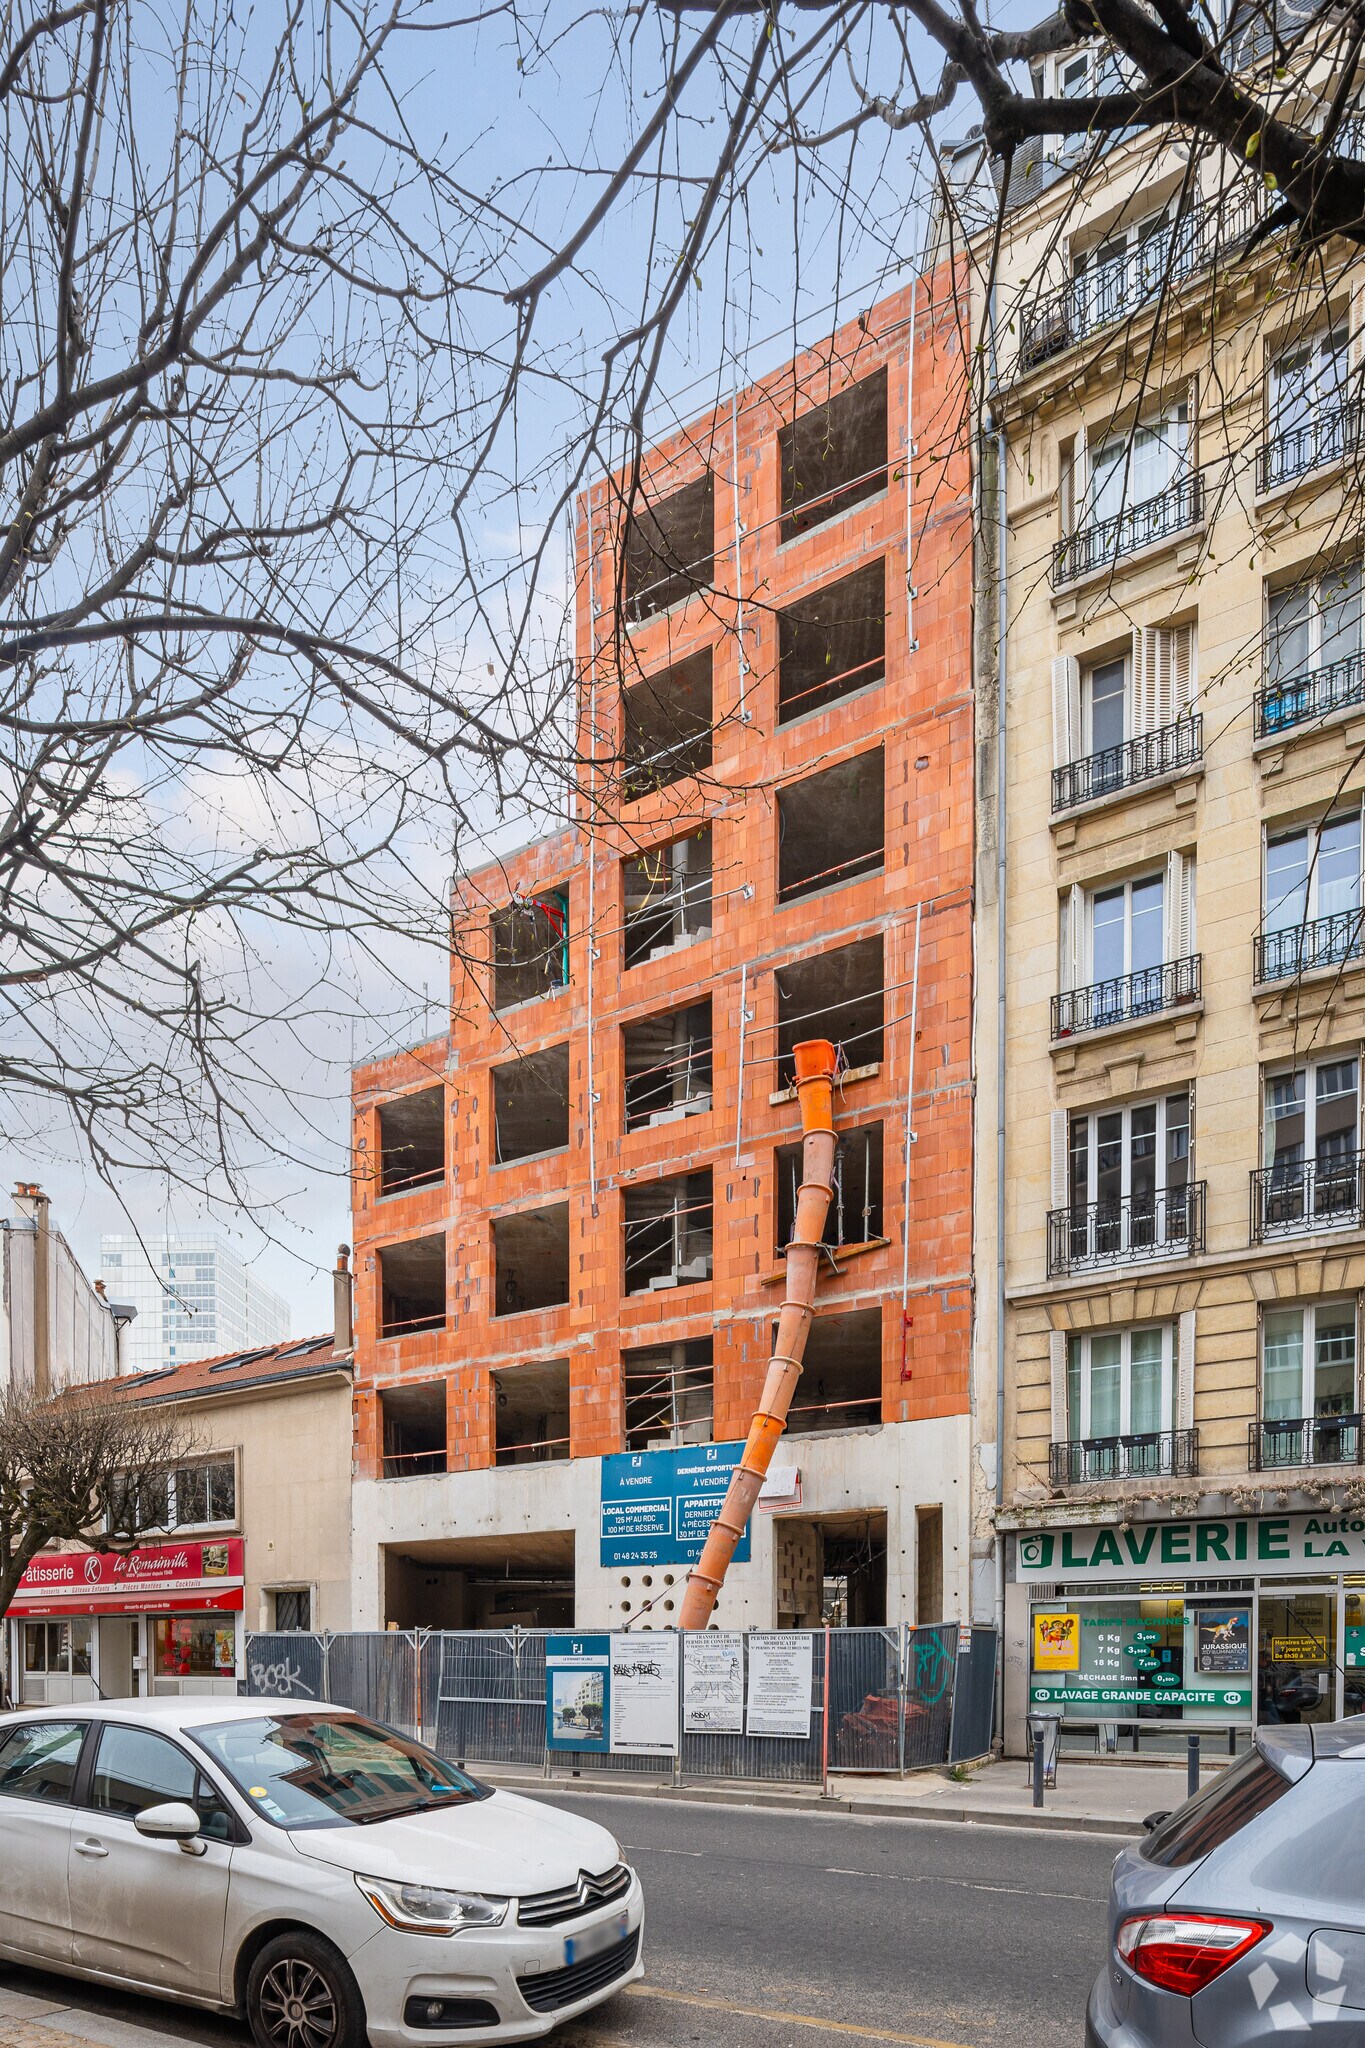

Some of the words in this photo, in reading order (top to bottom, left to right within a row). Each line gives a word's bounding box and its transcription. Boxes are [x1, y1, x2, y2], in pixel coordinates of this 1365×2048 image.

[677, 1466, 705, 1475] DERNIÈRE
[620, 1477, 625, 1486] À
[626, 1476, 652, 1485] VENDRE
[693, 1478, 699, 1487] À
[700, 1476, 729, 1486] VENDRE
[603, 1507, 624, 1515] LOCAL
[625, 1504, 670, 1514] COMMERCIAL
[685, 1510, 713, 1519] DERNIER
[635, 1523, 664, 1531] RÉSERVE
[687, 1519, 711, 1528] PIÈCES
[1062, 1519, 1290, 1567] LAVERIE
[687, 1549, 694, 1557] 01
[1304, 1540, 1350, 1557] LA
[114, 1556, 127, 1572] La
[22, 1564, 74, 1582] âtisserie
[175, 1580, 201, 1588] Cocktails
[1126, 1617, 1190, 1627] MACHINES
[1098, 1634, 1104, 1642] 6
[1107, 1634, 1121, 1643] Kg
[1107, 1646, 1120, 1655] Kg
[1107, 1659, 1120, 1667] Kg
[1078, 1673, 1118, 1681] SÉCHAGE
[1054, 1690, 1099, 1700] LAVAGE
[1101, 1691, 1150, 1700] GRANDE
[1154, 1692, 1215, 1702] CAPACITE
